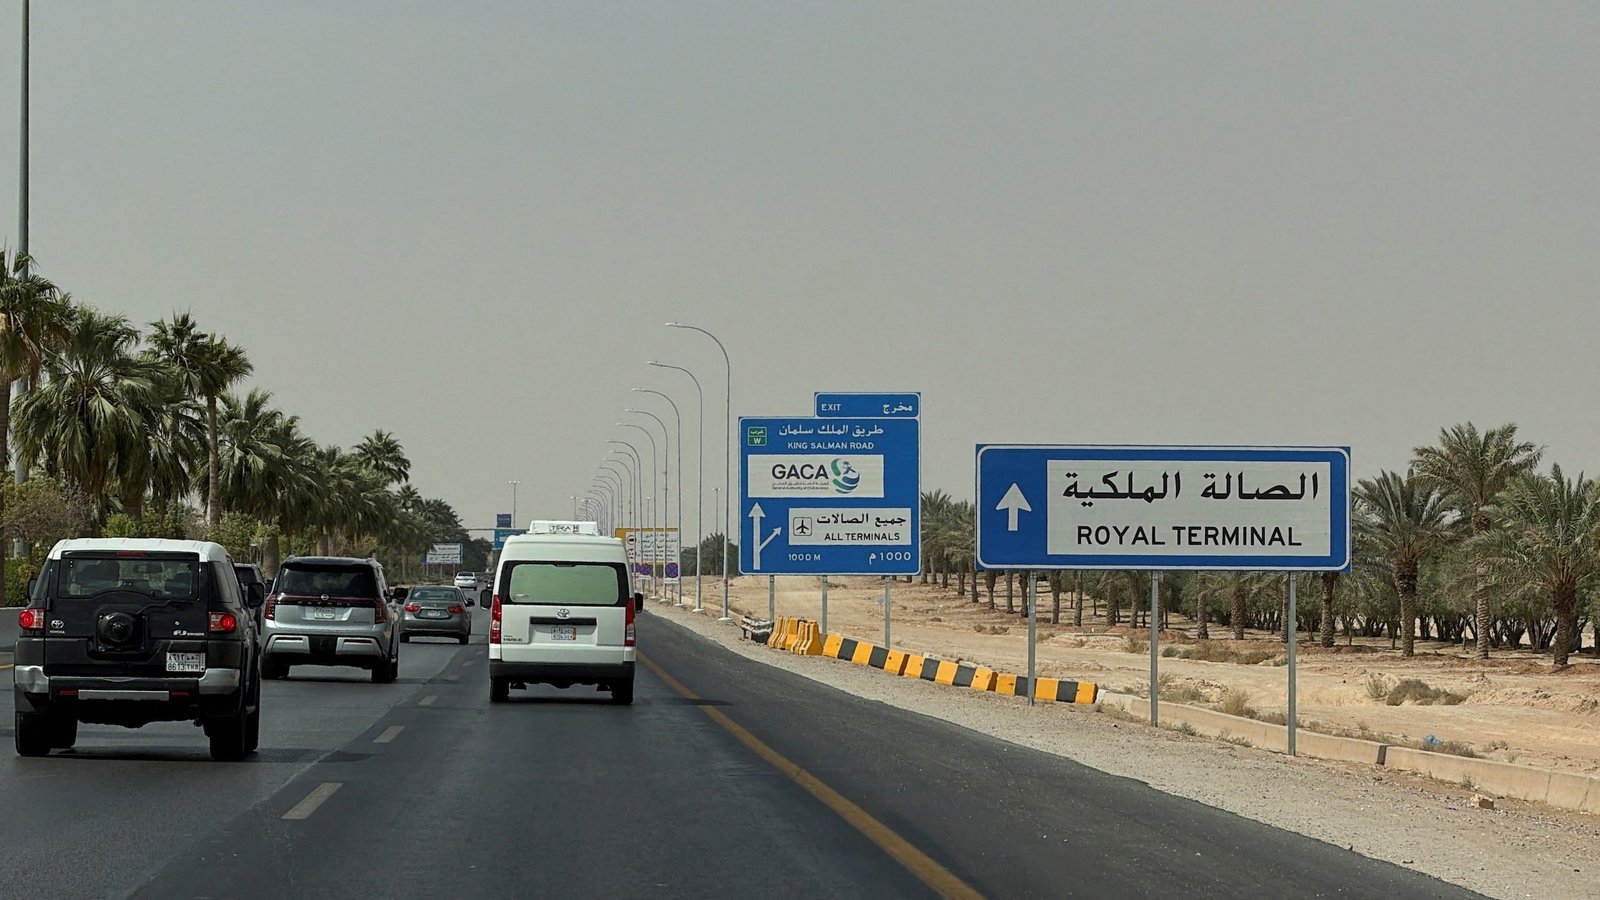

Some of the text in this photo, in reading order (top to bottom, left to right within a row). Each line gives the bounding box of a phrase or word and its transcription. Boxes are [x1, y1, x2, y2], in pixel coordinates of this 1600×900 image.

[821, 403, 842, 412] EXIT
[882, 402, 913, 415] مخرج
[778, 424, 884, 437] طريق الملك سلمان
[787, 441, 875, 450] KING SALMAN ROAD
[771, 463, 829, 480] GACA
[1062, 470, 1319, 508] الصالة الملكية
[816, 513, 907, 528] جميع الصالات
[824, 532, 900, 541] ALL TERMINALS
[1077, 525, 1303, 546] ROYAL TERMINAL
[788, 553, 821, 562] 1000 M
[868, 551, 912, 565] 1000 م
